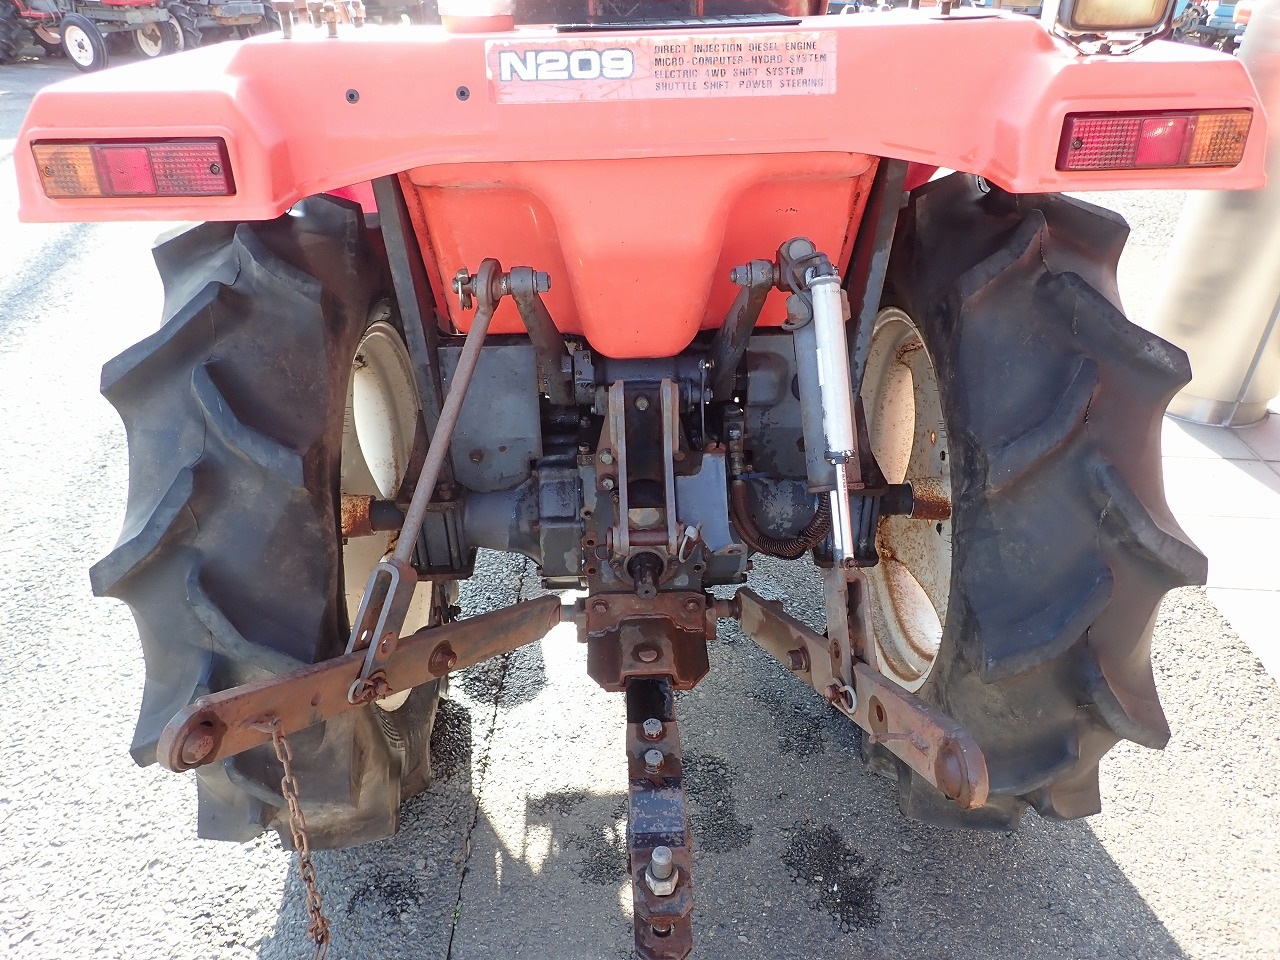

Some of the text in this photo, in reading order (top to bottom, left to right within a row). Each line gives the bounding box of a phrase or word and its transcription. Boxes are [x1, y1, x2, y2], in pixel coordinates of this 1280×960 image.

[654, 42, 817, 53] DIRECT INJECTION DIESEL ENGINE
[499, 47, 635, 81] N209
[789, 54, 827, 63] SYSTEM
[654, 67, 804, 78] ELECTRIC 4WD SHIFT SYSTEM
[656, 79, 824, 91] SHUTTLE SHIFT POWER STEERING
